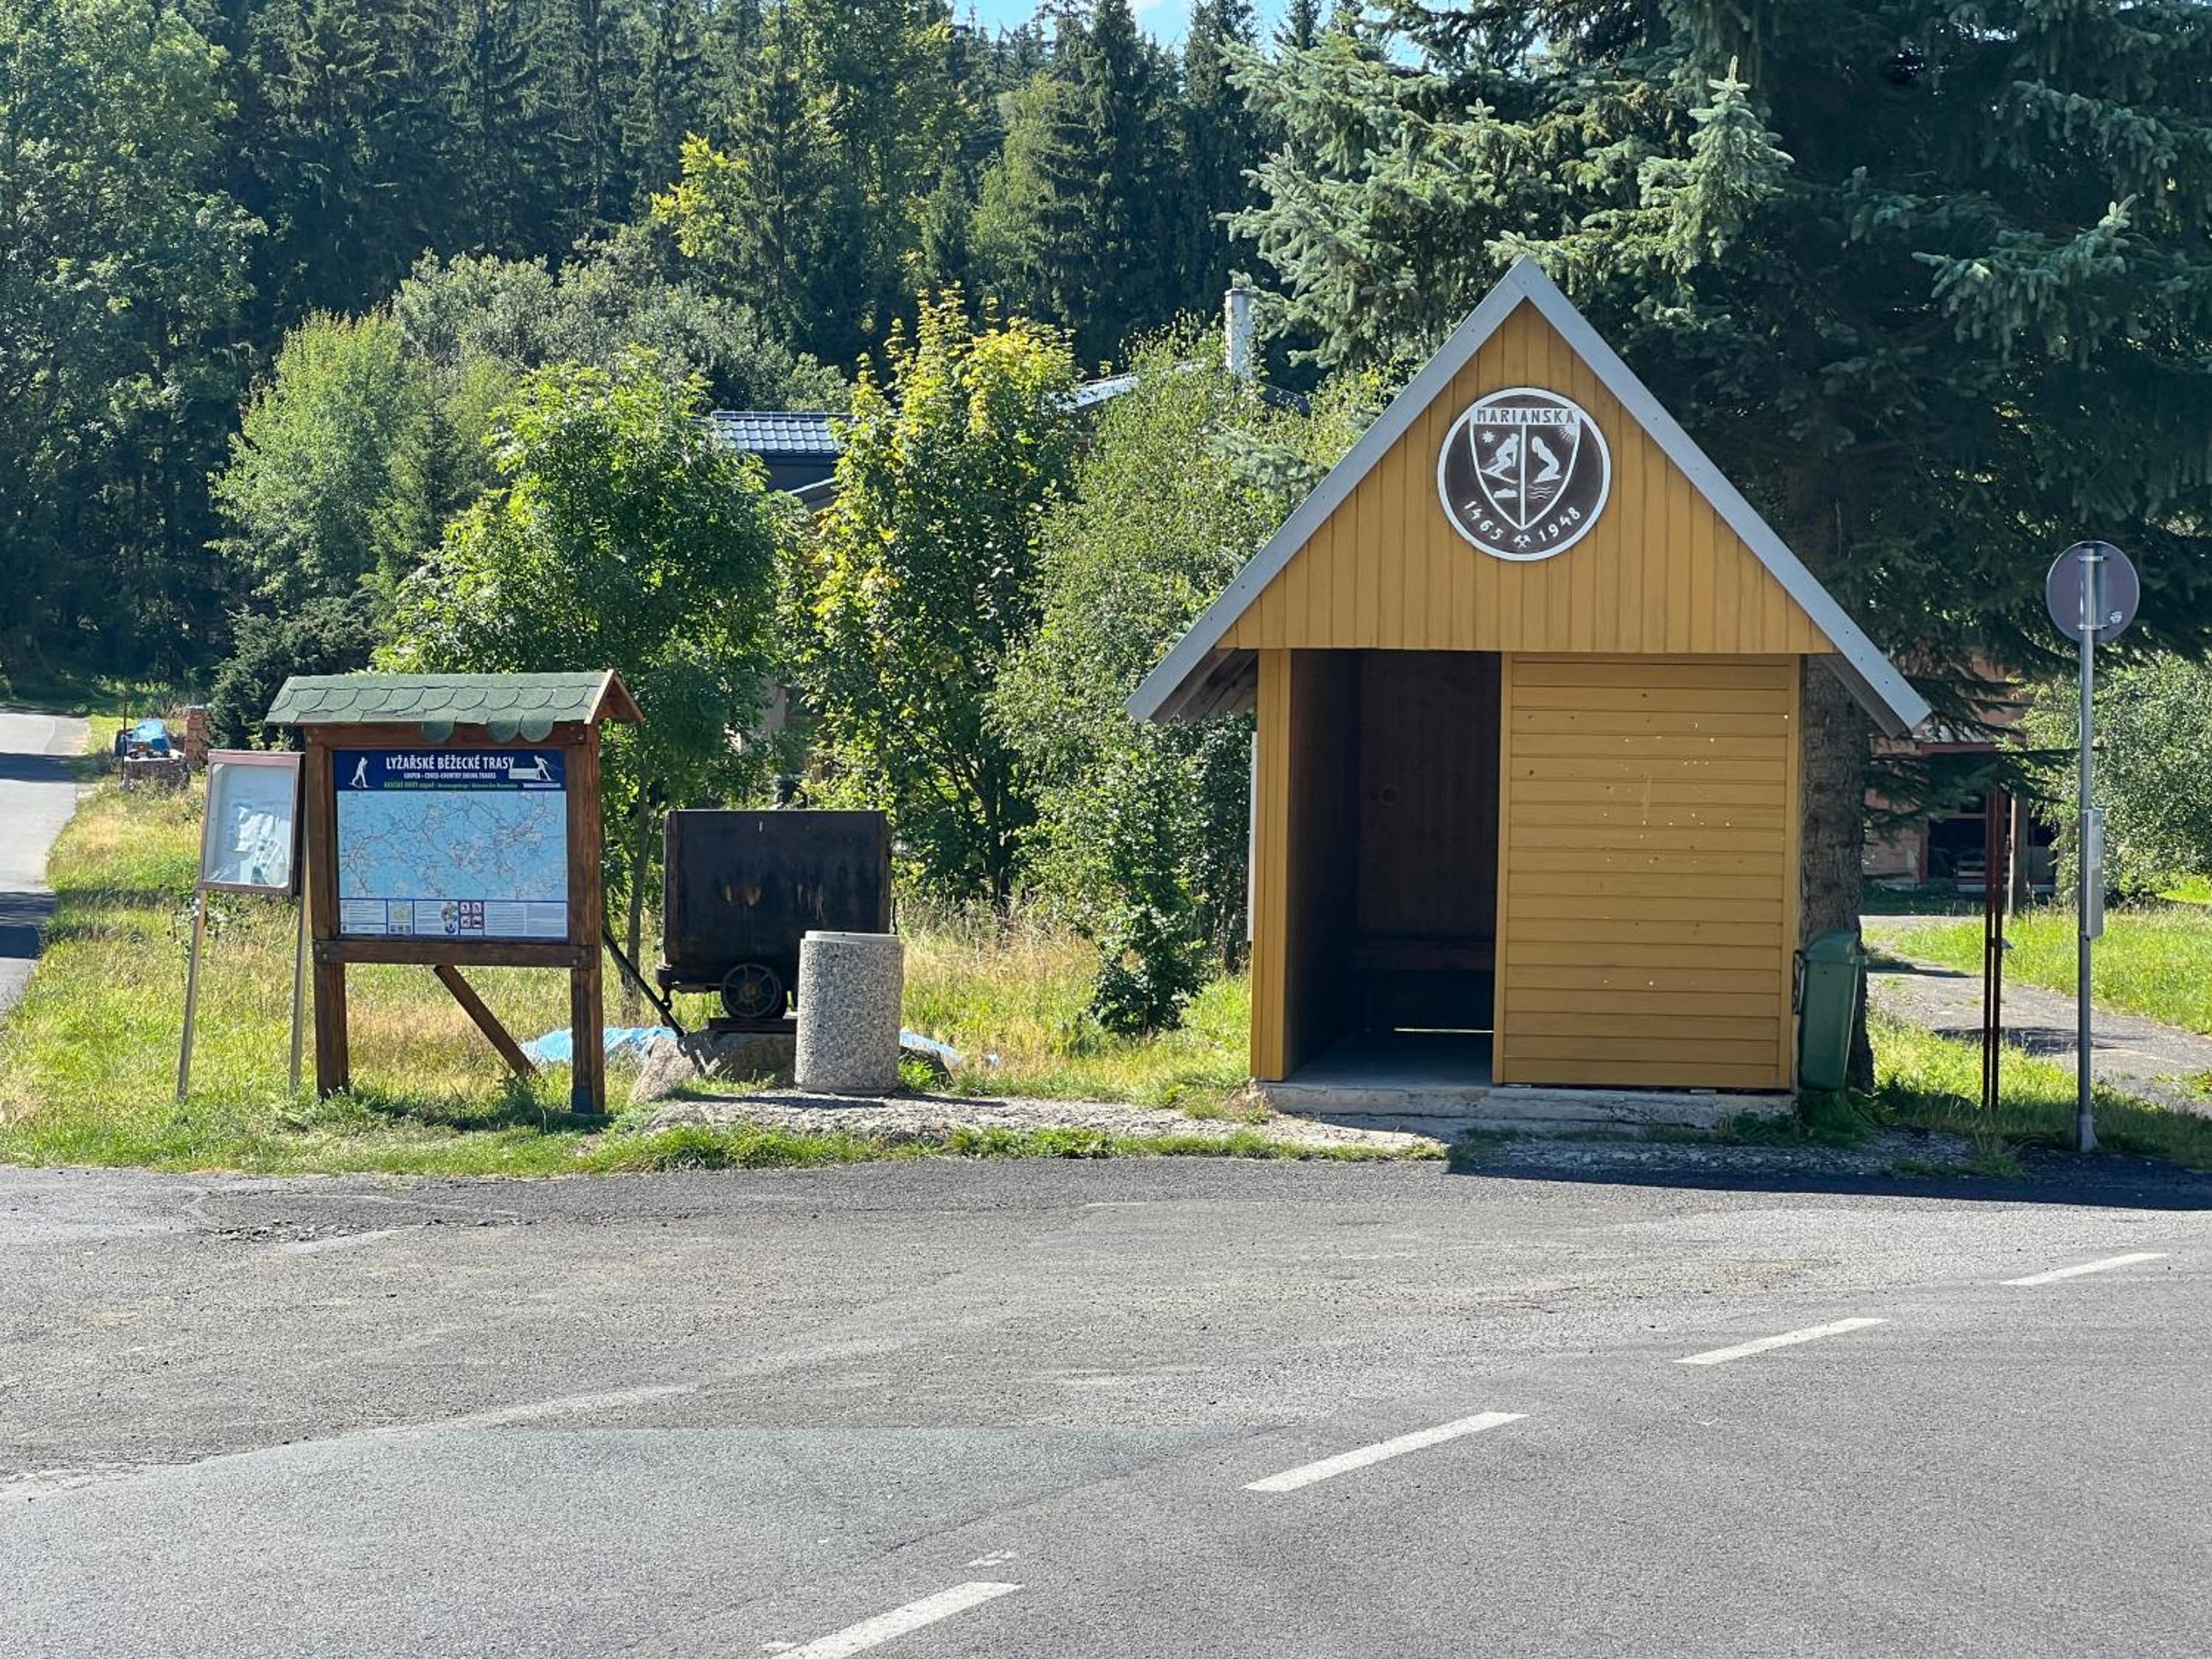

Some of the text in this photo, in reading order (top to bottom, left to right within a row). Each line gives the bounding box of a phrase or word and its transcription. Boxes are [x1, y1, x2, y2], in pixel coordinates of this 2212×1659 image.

[1464, 501, 1581, 542] 1465 1948
[386, 754, 514, 770] LYŽAŘSKÉ BĚŽECKÉ TRASY
